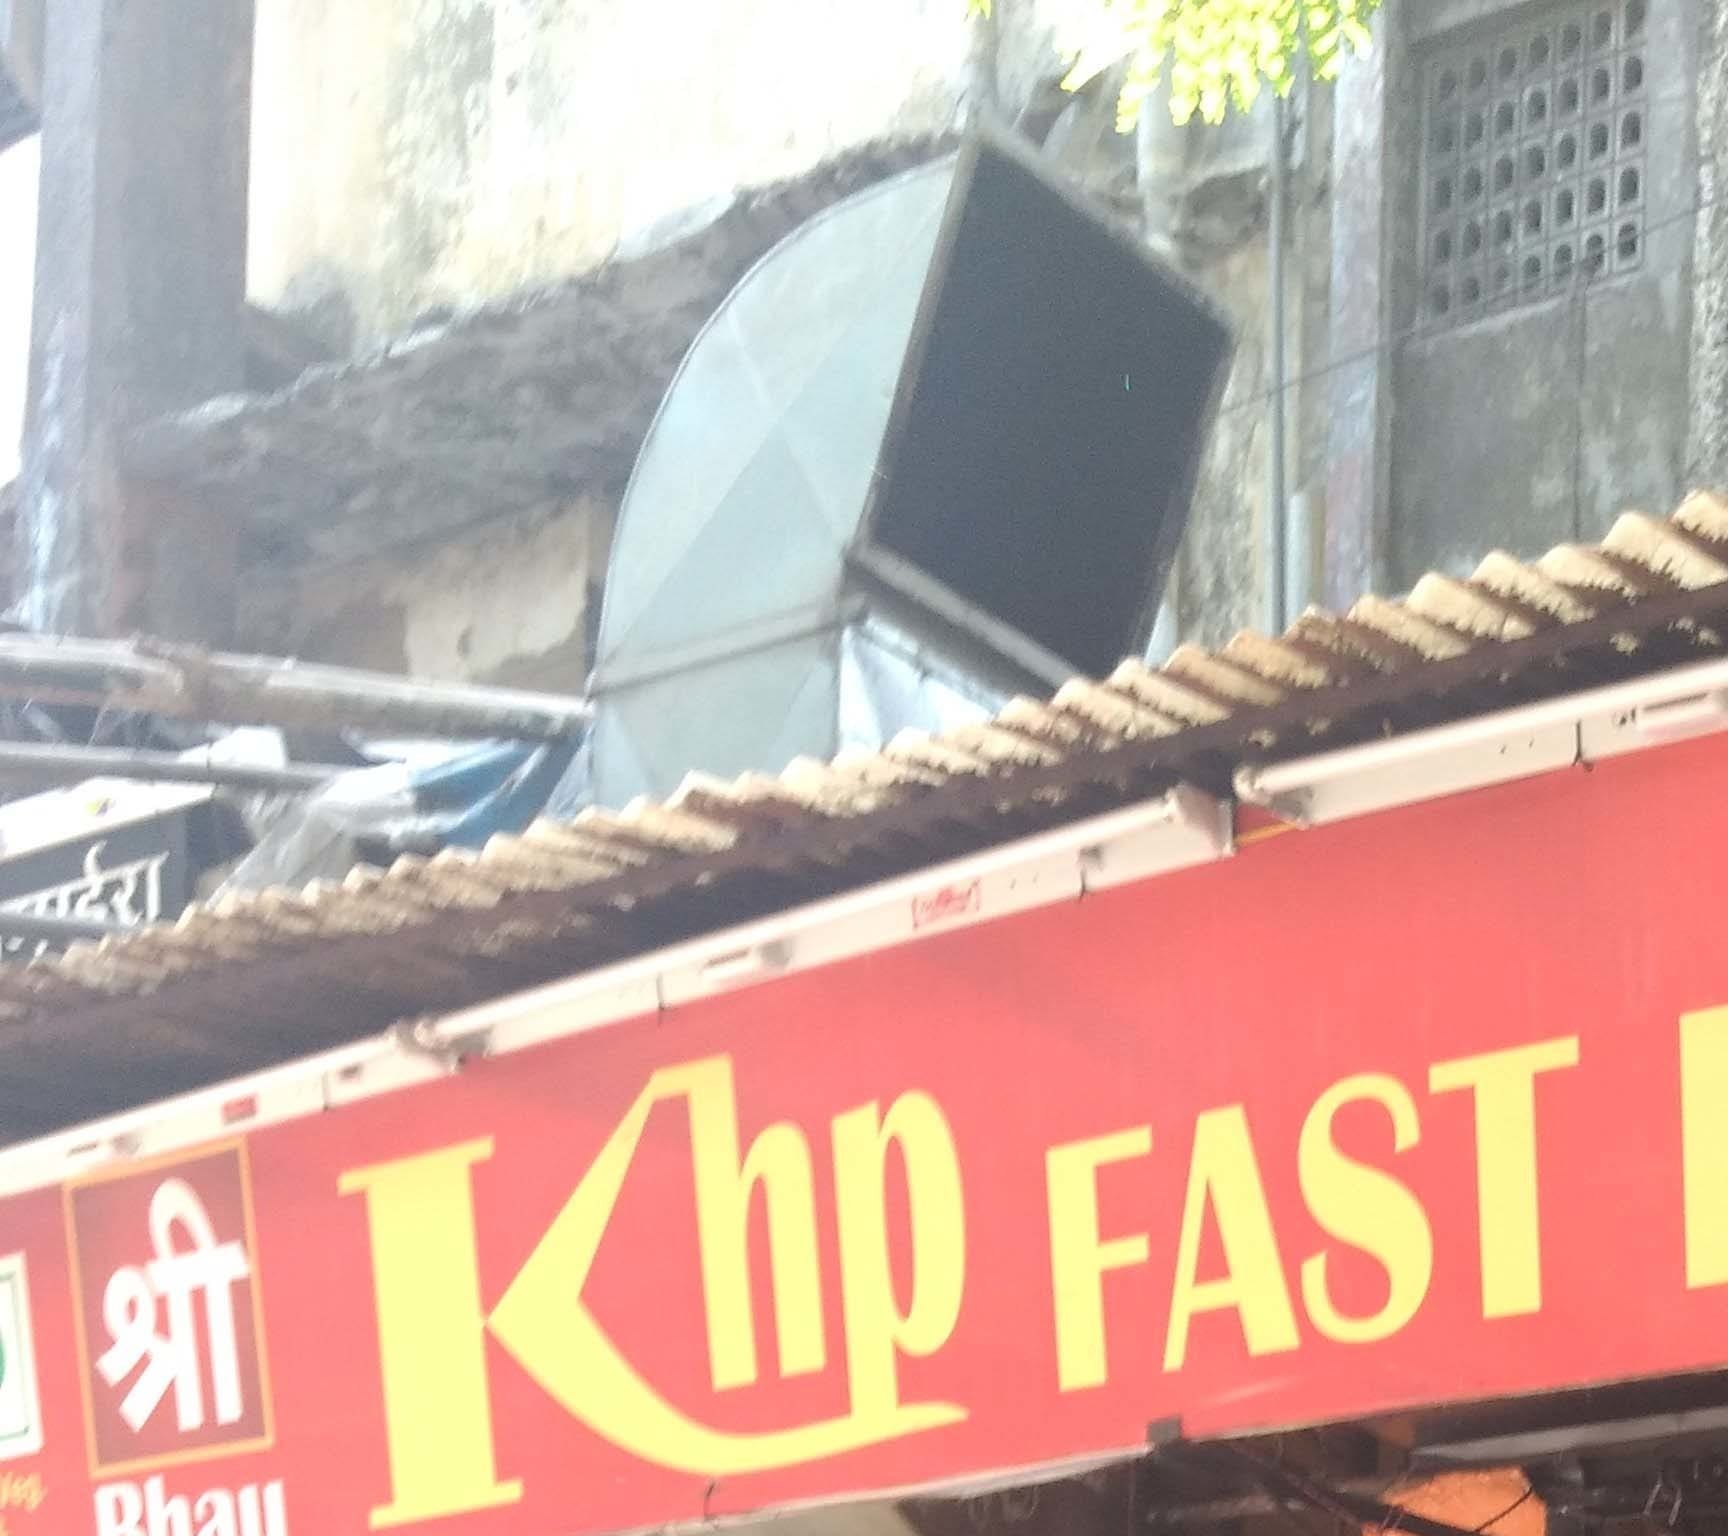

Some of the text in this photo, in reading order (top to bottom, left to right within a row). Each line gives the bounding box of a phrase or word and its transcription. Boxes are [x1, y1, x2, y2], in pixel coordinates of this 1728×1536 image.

[97, 1178, 250, 1434] श्री
[338, 1053, 968, 1530] Khp
[1045, 1035, 1580, 1395] FAST
